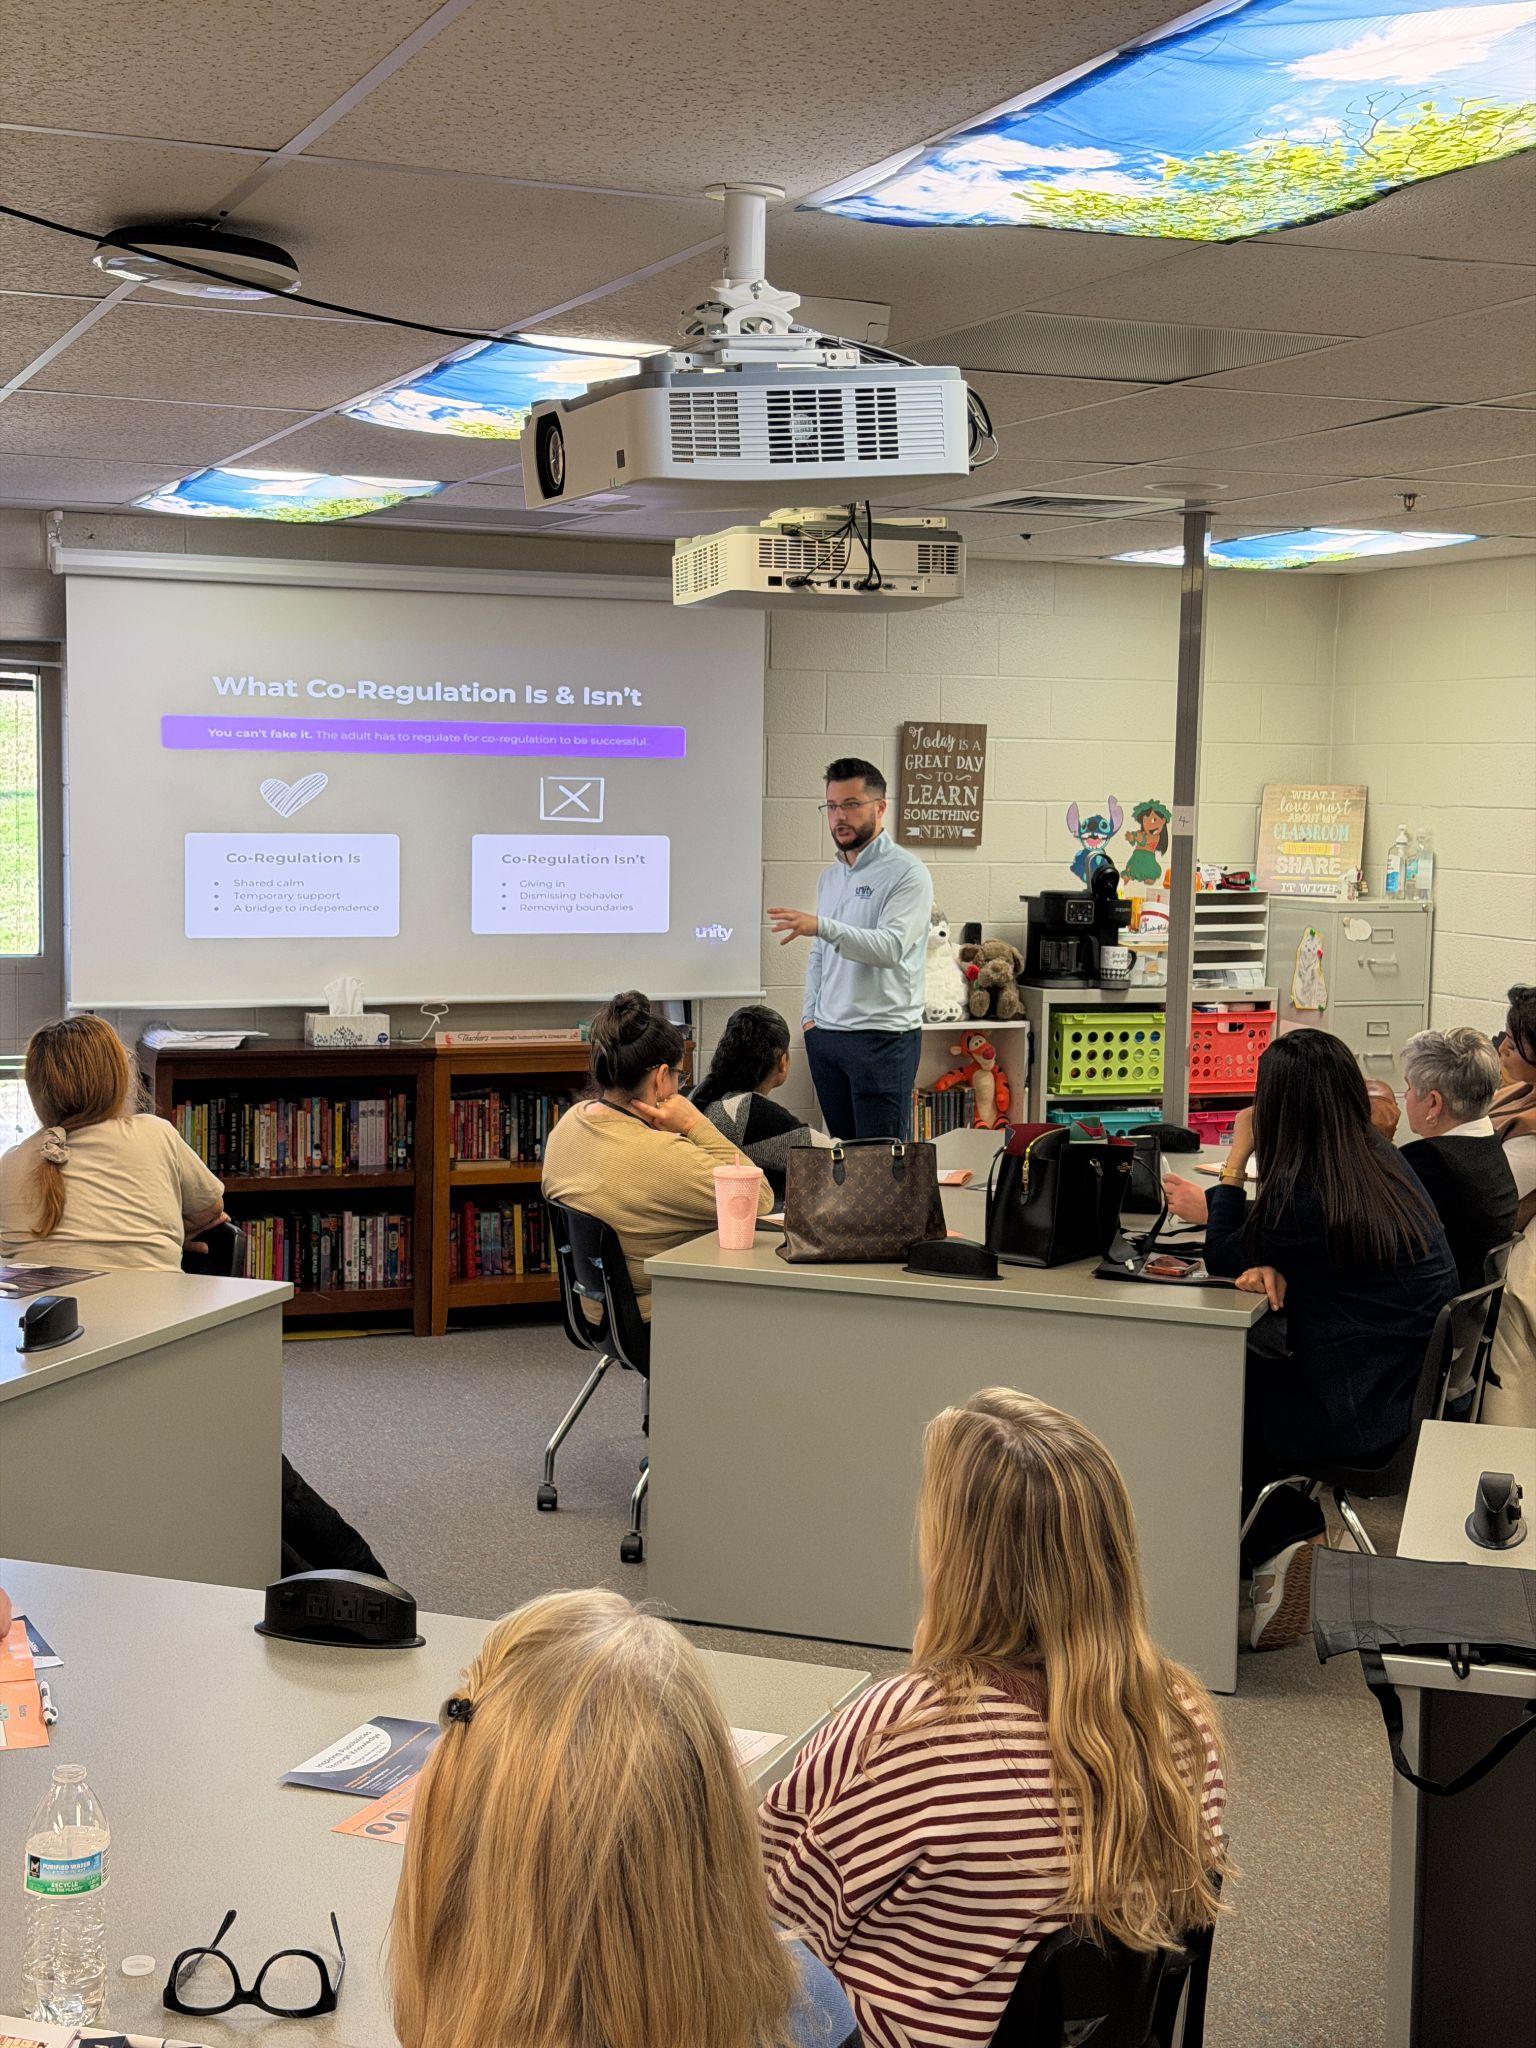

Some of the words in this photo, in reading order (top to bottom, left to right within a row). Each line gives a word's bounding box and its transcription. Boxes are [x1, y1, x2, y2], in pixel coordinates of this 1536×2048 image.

[212, 676, 298, 698] What
[306, 678, 516, 705] Co-Regulation
[525, 685, 548, 704] Is
[555, 685, 575, 705] &
[583, 686, 642, 707] Isn't
[208, 728, 232, 739] You
[236, 728, 267, 739] can't
[270, 728, 297, 739] fake
[300, 729, 313, 740] it.
[317, 730, 338, 740] The
[341, 730, 371, 741] adult
[375, 731, 395, 741] has
[398, 732, 410, 742] to
[412, 732, 460, 745] regulate
[463, 733, 479, 743] for
[481, 733, 557, 746] co-regulation
[560, 735, 571, 745] to
[573, 735, 588, 745] be
[591, 735, 649, 747] successful.
[908, 726, 956, 752] Today
[959, 739, 969, 751] IS
[972, 740, 982, 751] A
[905, 754, 951, 770] GREAT
[956, 756, 984, 773] DAY
[936, 772, 953, 782] TO
[906, 784, 979, 806] LEARN
[1292, 790, 1328, 800] WHAT
[1280, 796, 1311, 813] love
[1315, 799, 1352, 815] most
[904, 808, 980, 822] SOMETHING
[1288, 813, 1320, 823] ABOUT
[1322, 813, 1338, 824] MY
[919, 824, 964, 839] NEW
[1273, 823, 1350, 841] CLASSROOM
[226, 853, 343, 865] Co-Regulation
[348, 853, 360, 863] Is
[501, 853, 610, 866] Co-Regulation
[614, 854, 646, 865] Isn't
[1275, 856, 1341, 875] SHARE
[233, 879, 274, 888] Shared
[277, 879, 304, 888] calm
[519, 880, 552, 890] Giving
[555, 880, 566, 888] in
[1280, 882, 1296, 893] IT
[233, 891, 295, 902] Temporary
[297, 891, 340, 902] support
[579, 891, 624, 900] behavior
[233, 904, 242, 912] A
[245, 904, 282, 914] bridge
[299, 904, 380, 914] independence
[519, 903, 573, 913] Removing
[576, 903, 634, 912] boundaries
[695, 924, 733, 942] unity
[70, 1861, 91, 1870] WATER
